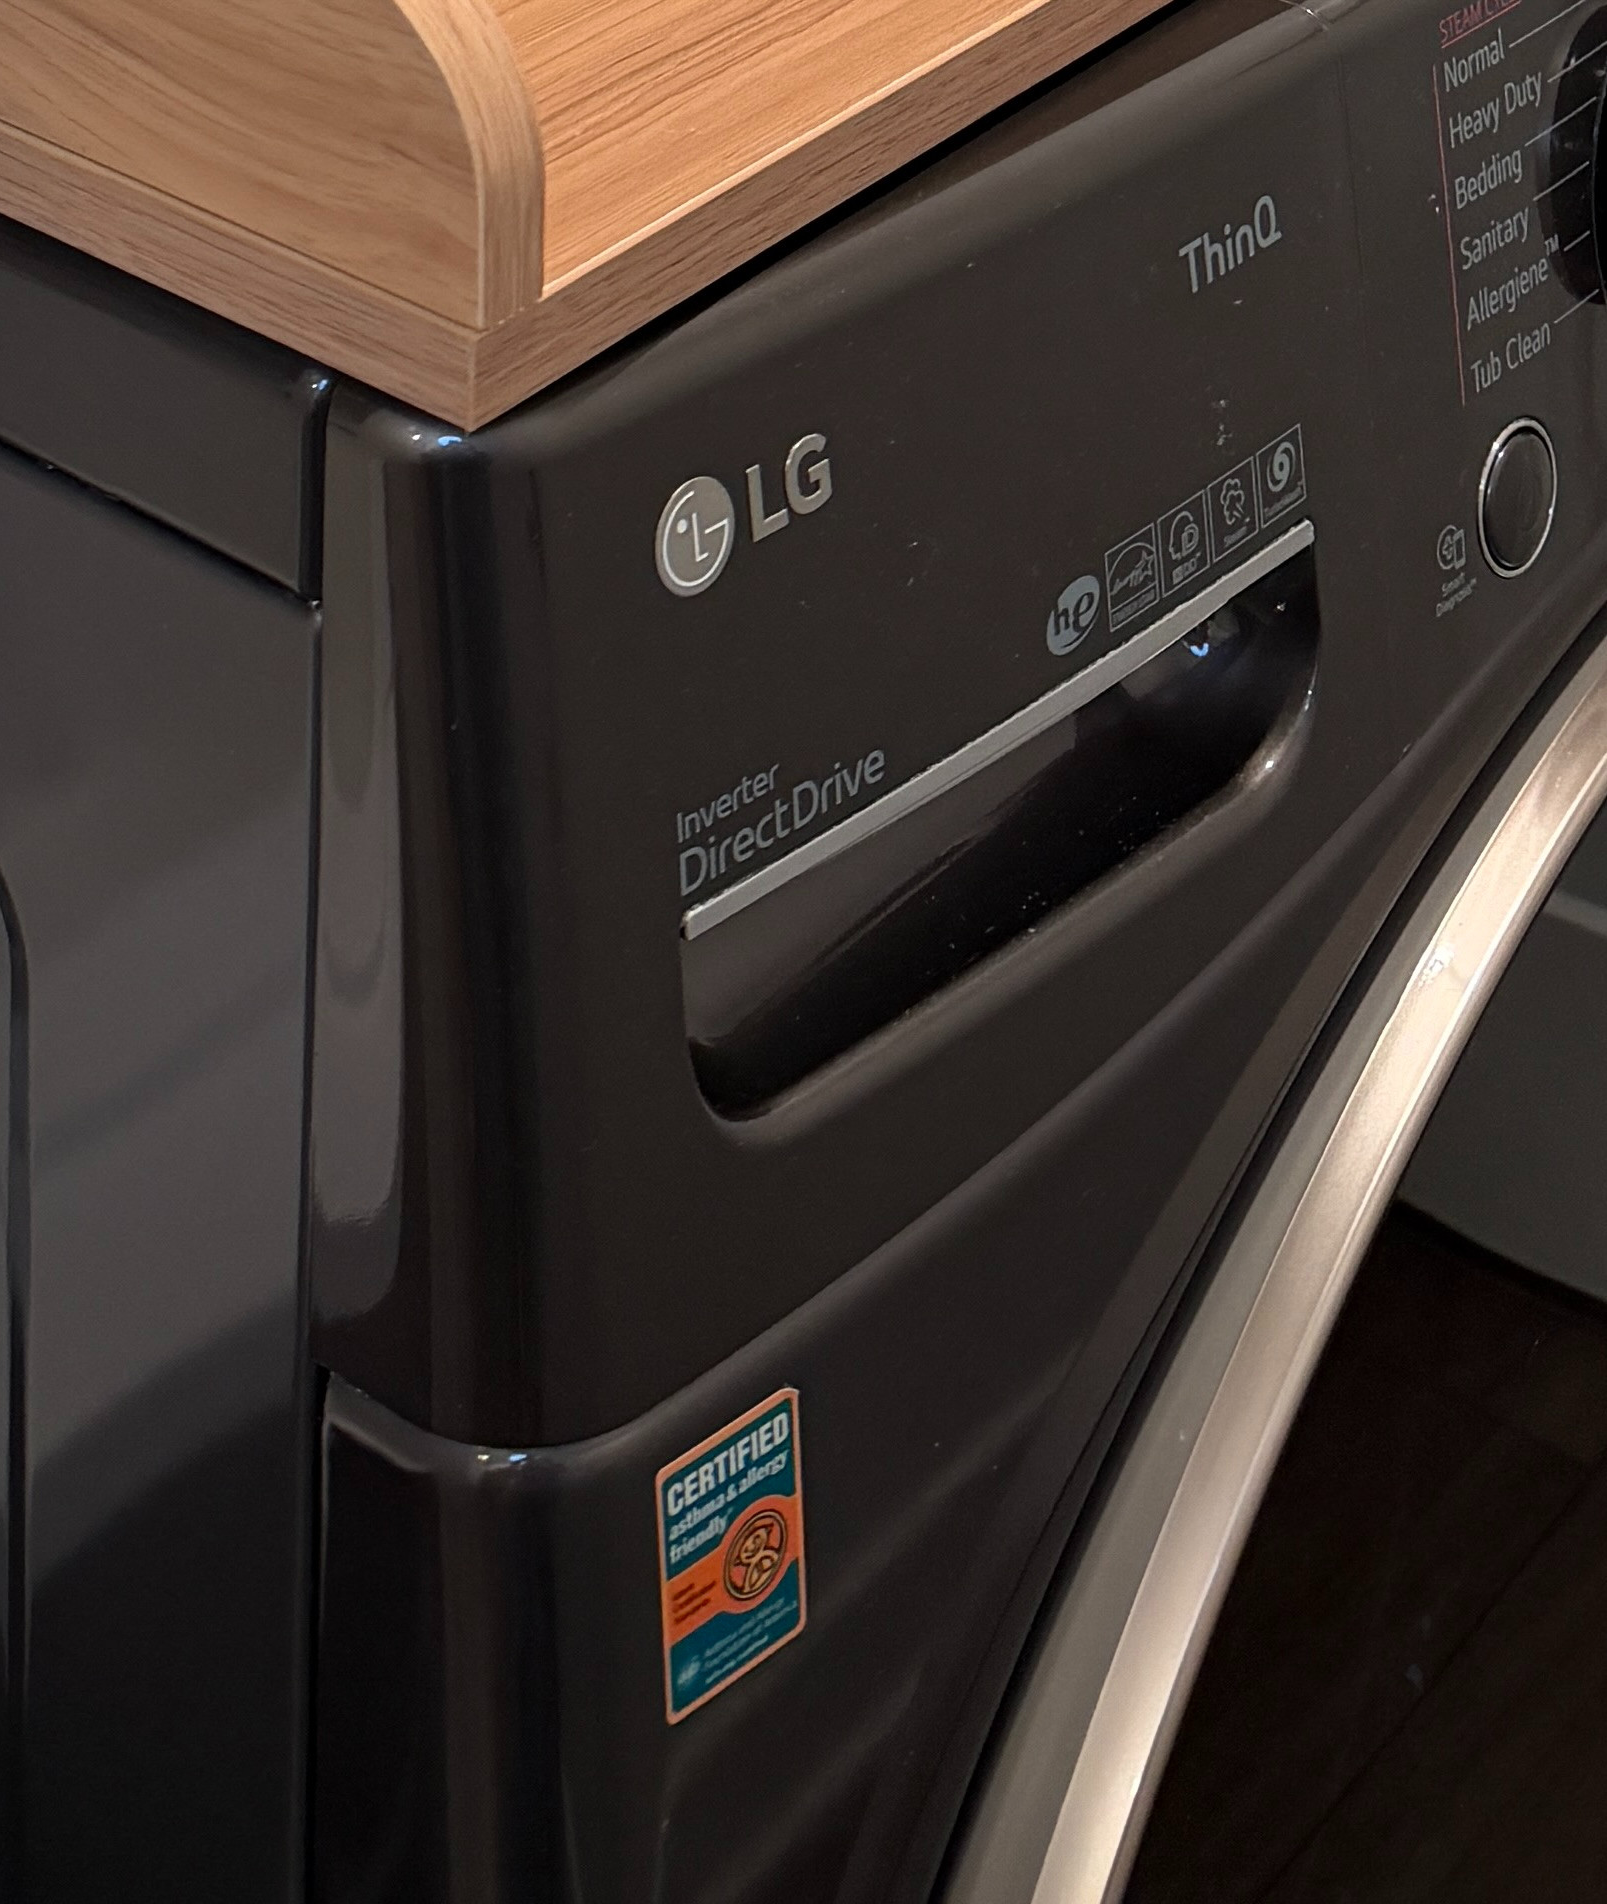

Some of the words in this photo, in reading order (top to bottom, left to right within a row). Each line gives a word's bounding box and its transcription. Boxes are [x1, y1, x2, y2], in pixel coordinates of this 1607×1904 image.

[1439, 0, 1484, 42] STEAM
[1444, 27, 1506, 92] Normal
[1449, 97, 1500, 149] Heavy
[1504, 71, 1542, 115] Duty
[1454, 149, 1523, 210] Bedding
[1178, 195, 1283, 294] ThinQ
[1460, 206, 1529, 271] Sanitary
[1471, 350, 1502, 394] Tub
[1506, 322, 1551, 370] Clean
[745, 432, 833, 543] LG
[677, 763, 780, 844] Inverter
[667, 1411, 790, 1517] CERTIFIED
[669, 1493, 726, 1541] asthma
[726, 1483, 738, 1503] &
[738, 1449, 791, 1494] allergy
